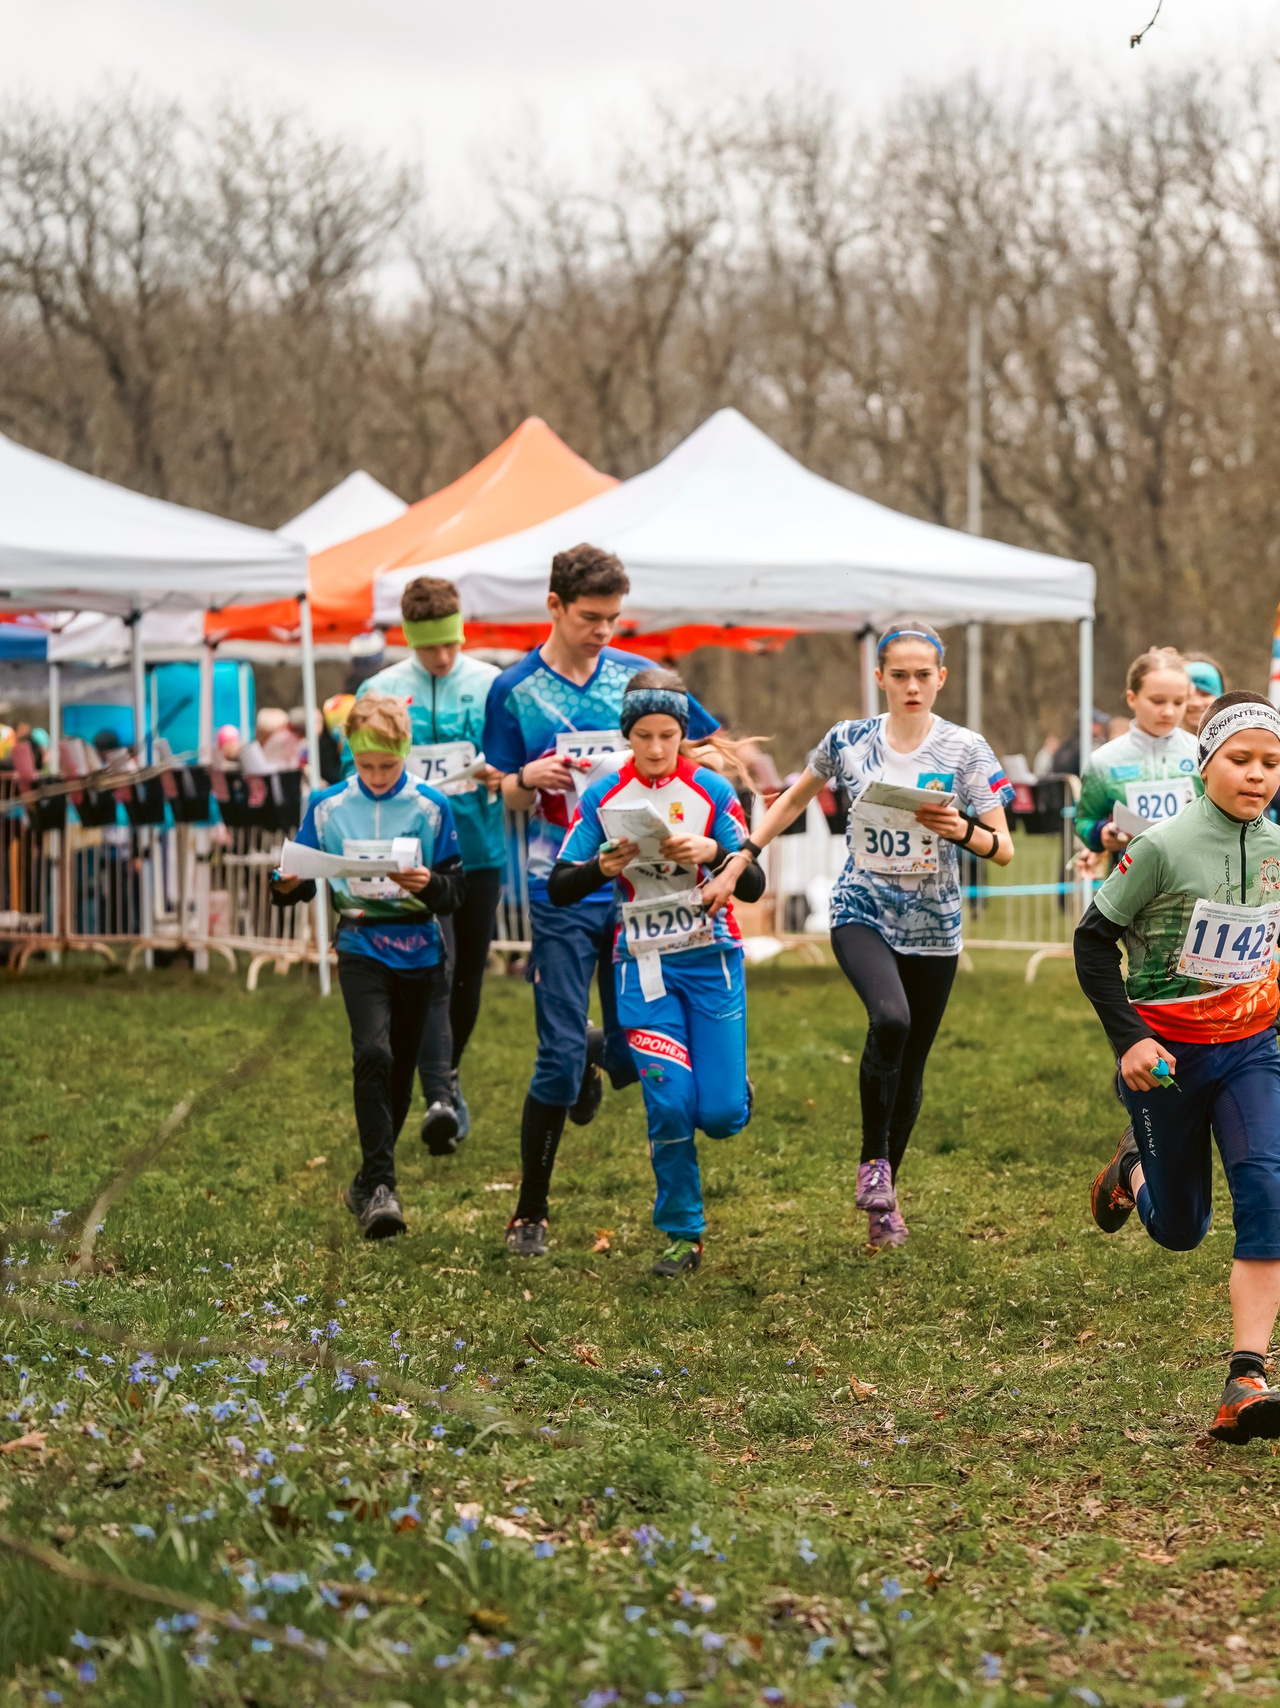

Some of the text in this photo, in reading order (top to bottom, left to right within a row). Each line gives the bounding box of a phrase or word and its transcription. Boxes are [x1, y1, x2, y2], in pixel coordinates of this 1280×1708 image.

[421, 758, 447, 781] 75
[1137, 793, 1177, 819] 820
[864, 827, 911, 858] 303
[629, 906, 693, 940] 1620
[1192, 919, 1266, 961] 1142
